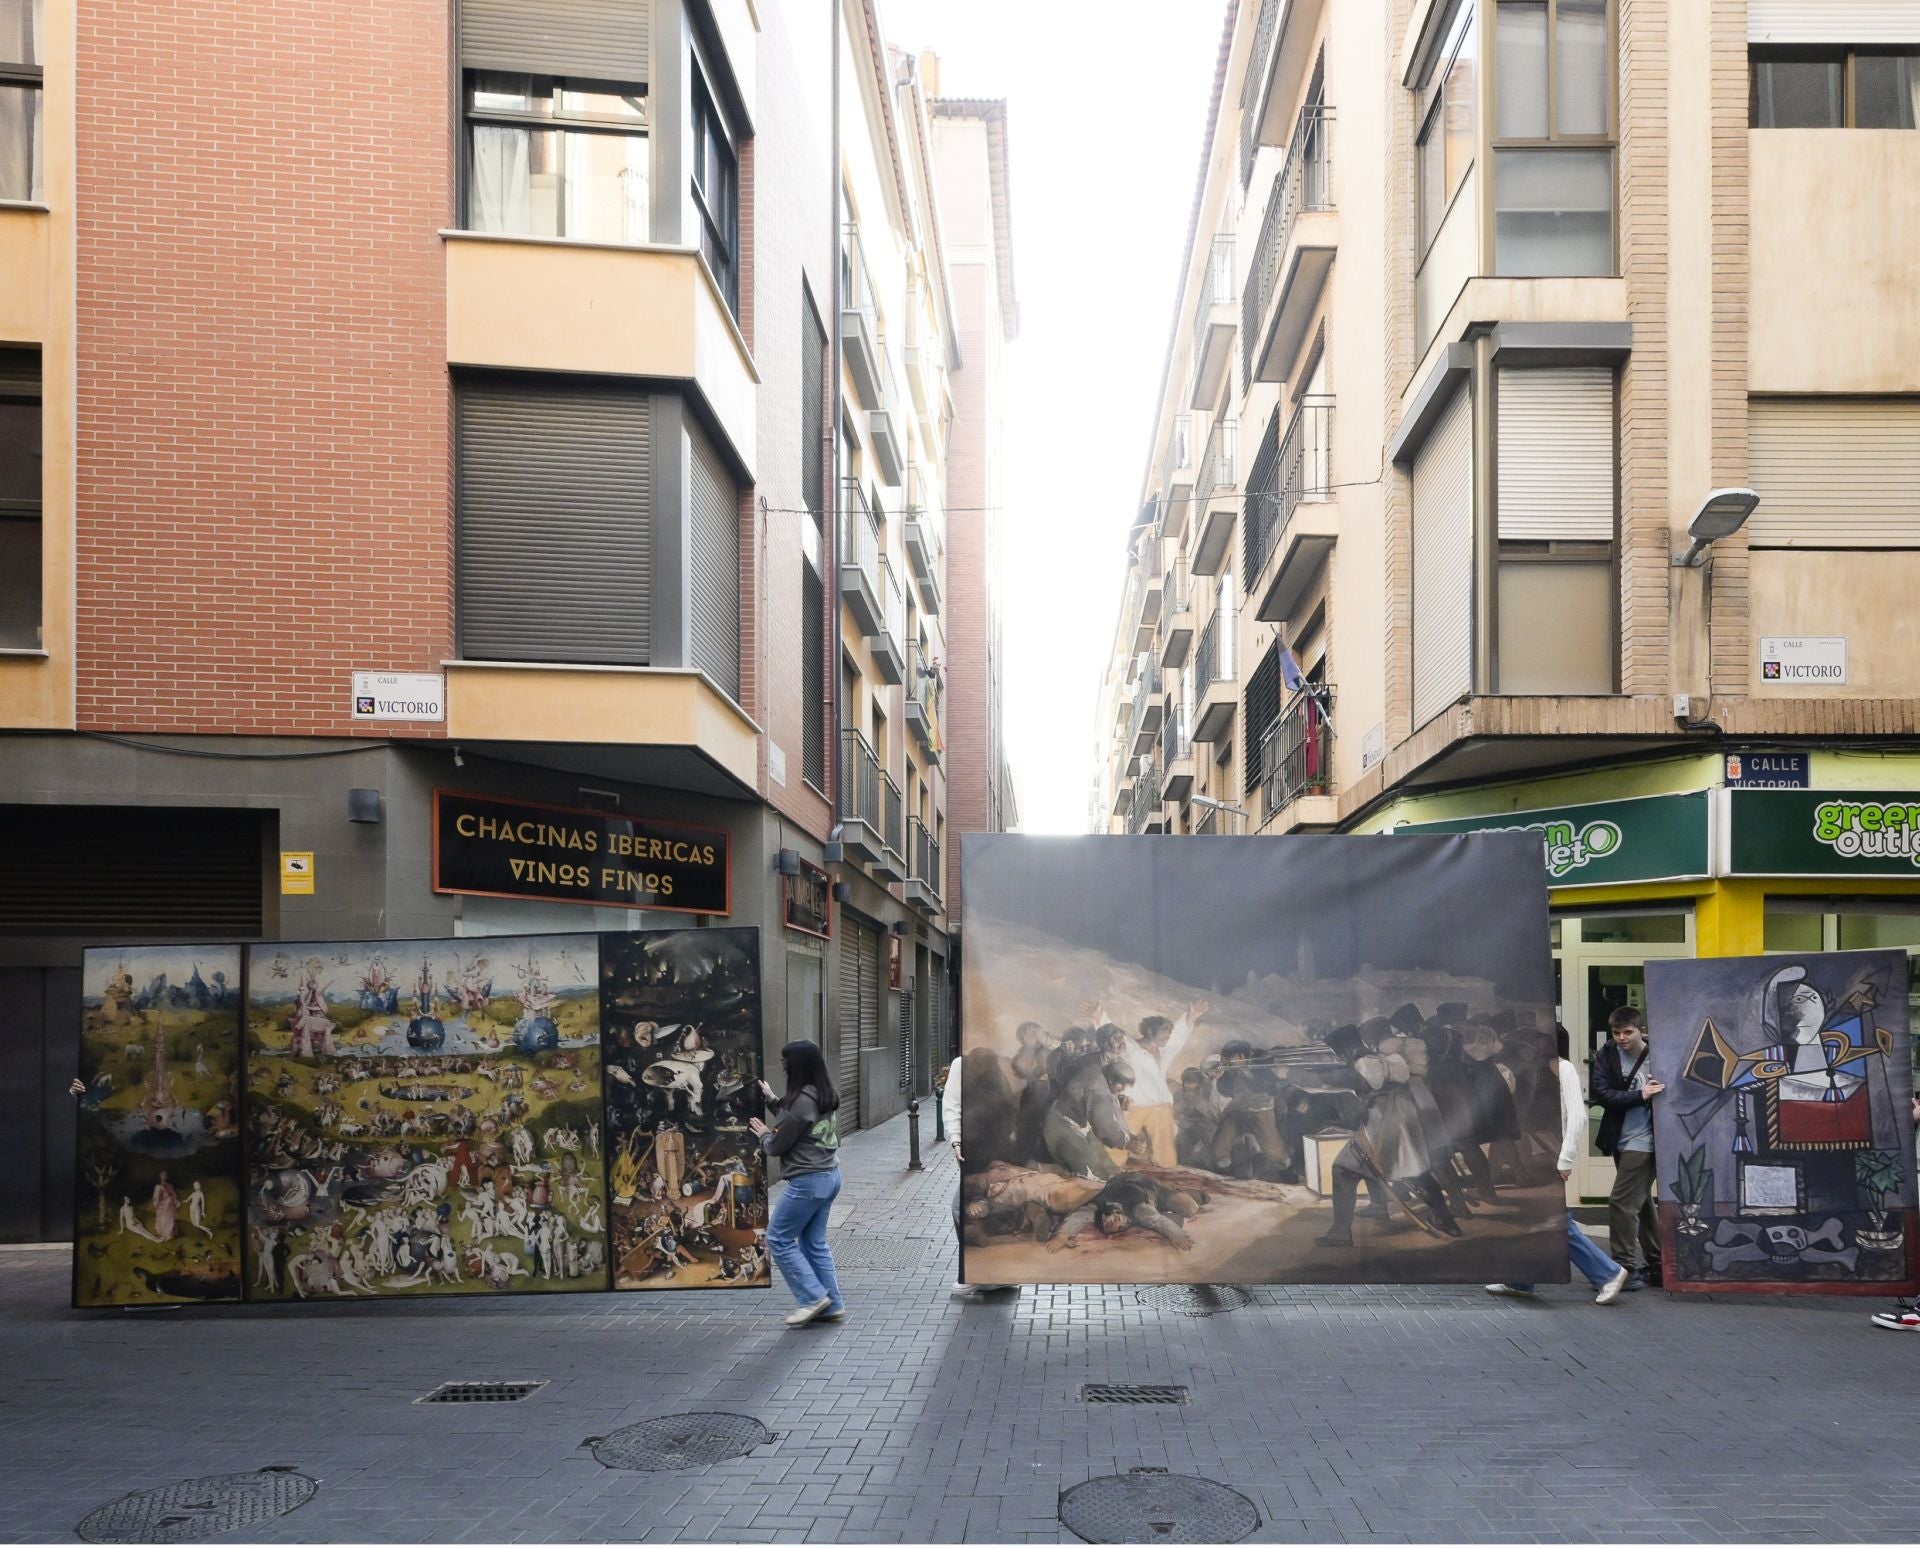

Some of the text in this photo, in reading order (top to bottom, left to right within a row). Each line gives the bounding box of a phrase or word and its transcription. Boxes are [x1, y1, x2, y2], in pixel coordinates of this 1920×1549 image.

[1784, 665, 1842, 678] VICTORIO
[377, 677, 398, 685] CALLE
[378, 700, 438, 714] VICTORIO
[1751, 757, 1800, 771] CALLE
[456, 813, 715, 866] CHACINAS IBERICAS
